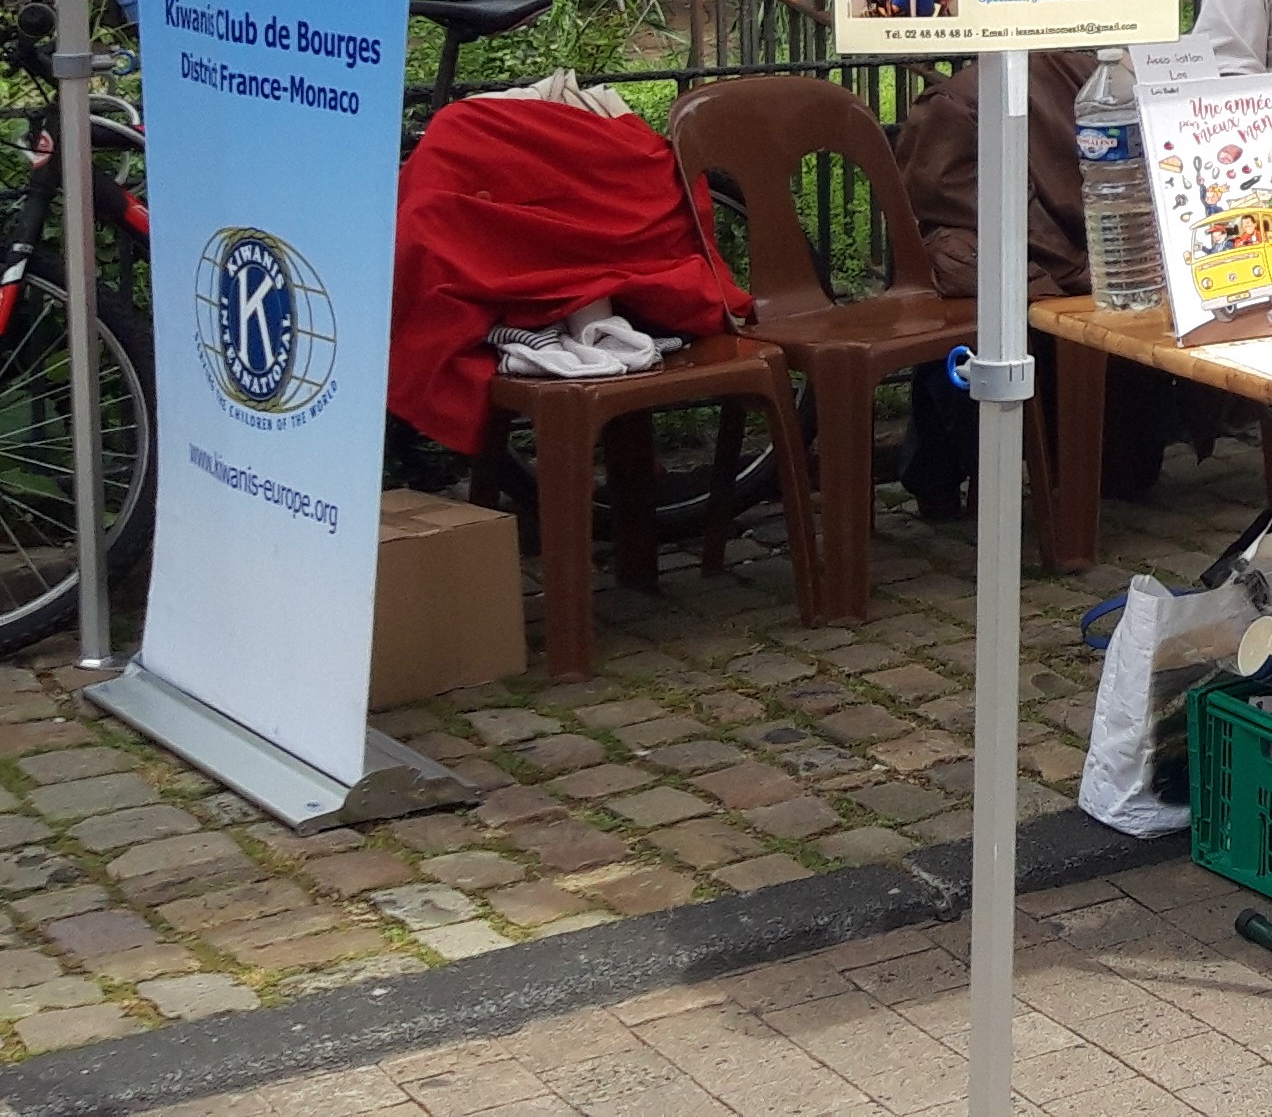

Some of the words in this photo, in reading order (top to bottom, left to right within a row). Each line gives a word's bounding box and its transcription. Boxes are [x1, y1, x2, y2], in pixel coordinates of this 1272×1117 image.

[215, 8, 257, 46] Club
[264, 16, 291, 50] de
[297, 20, 381, 69] Bourges
[981, 28, 1009, 38] Email
[220, 64, 359, 115] France-Monaco
[1190, 96, 1222, 120] Une
[1192, 116, 1241, 145] mieux
[226, 244, 285, 291] KIWANIS
[219, 296, 292, 394] INTERNATIONAL
[189, 441, 338, 535] www.kiwanis-europe.org
